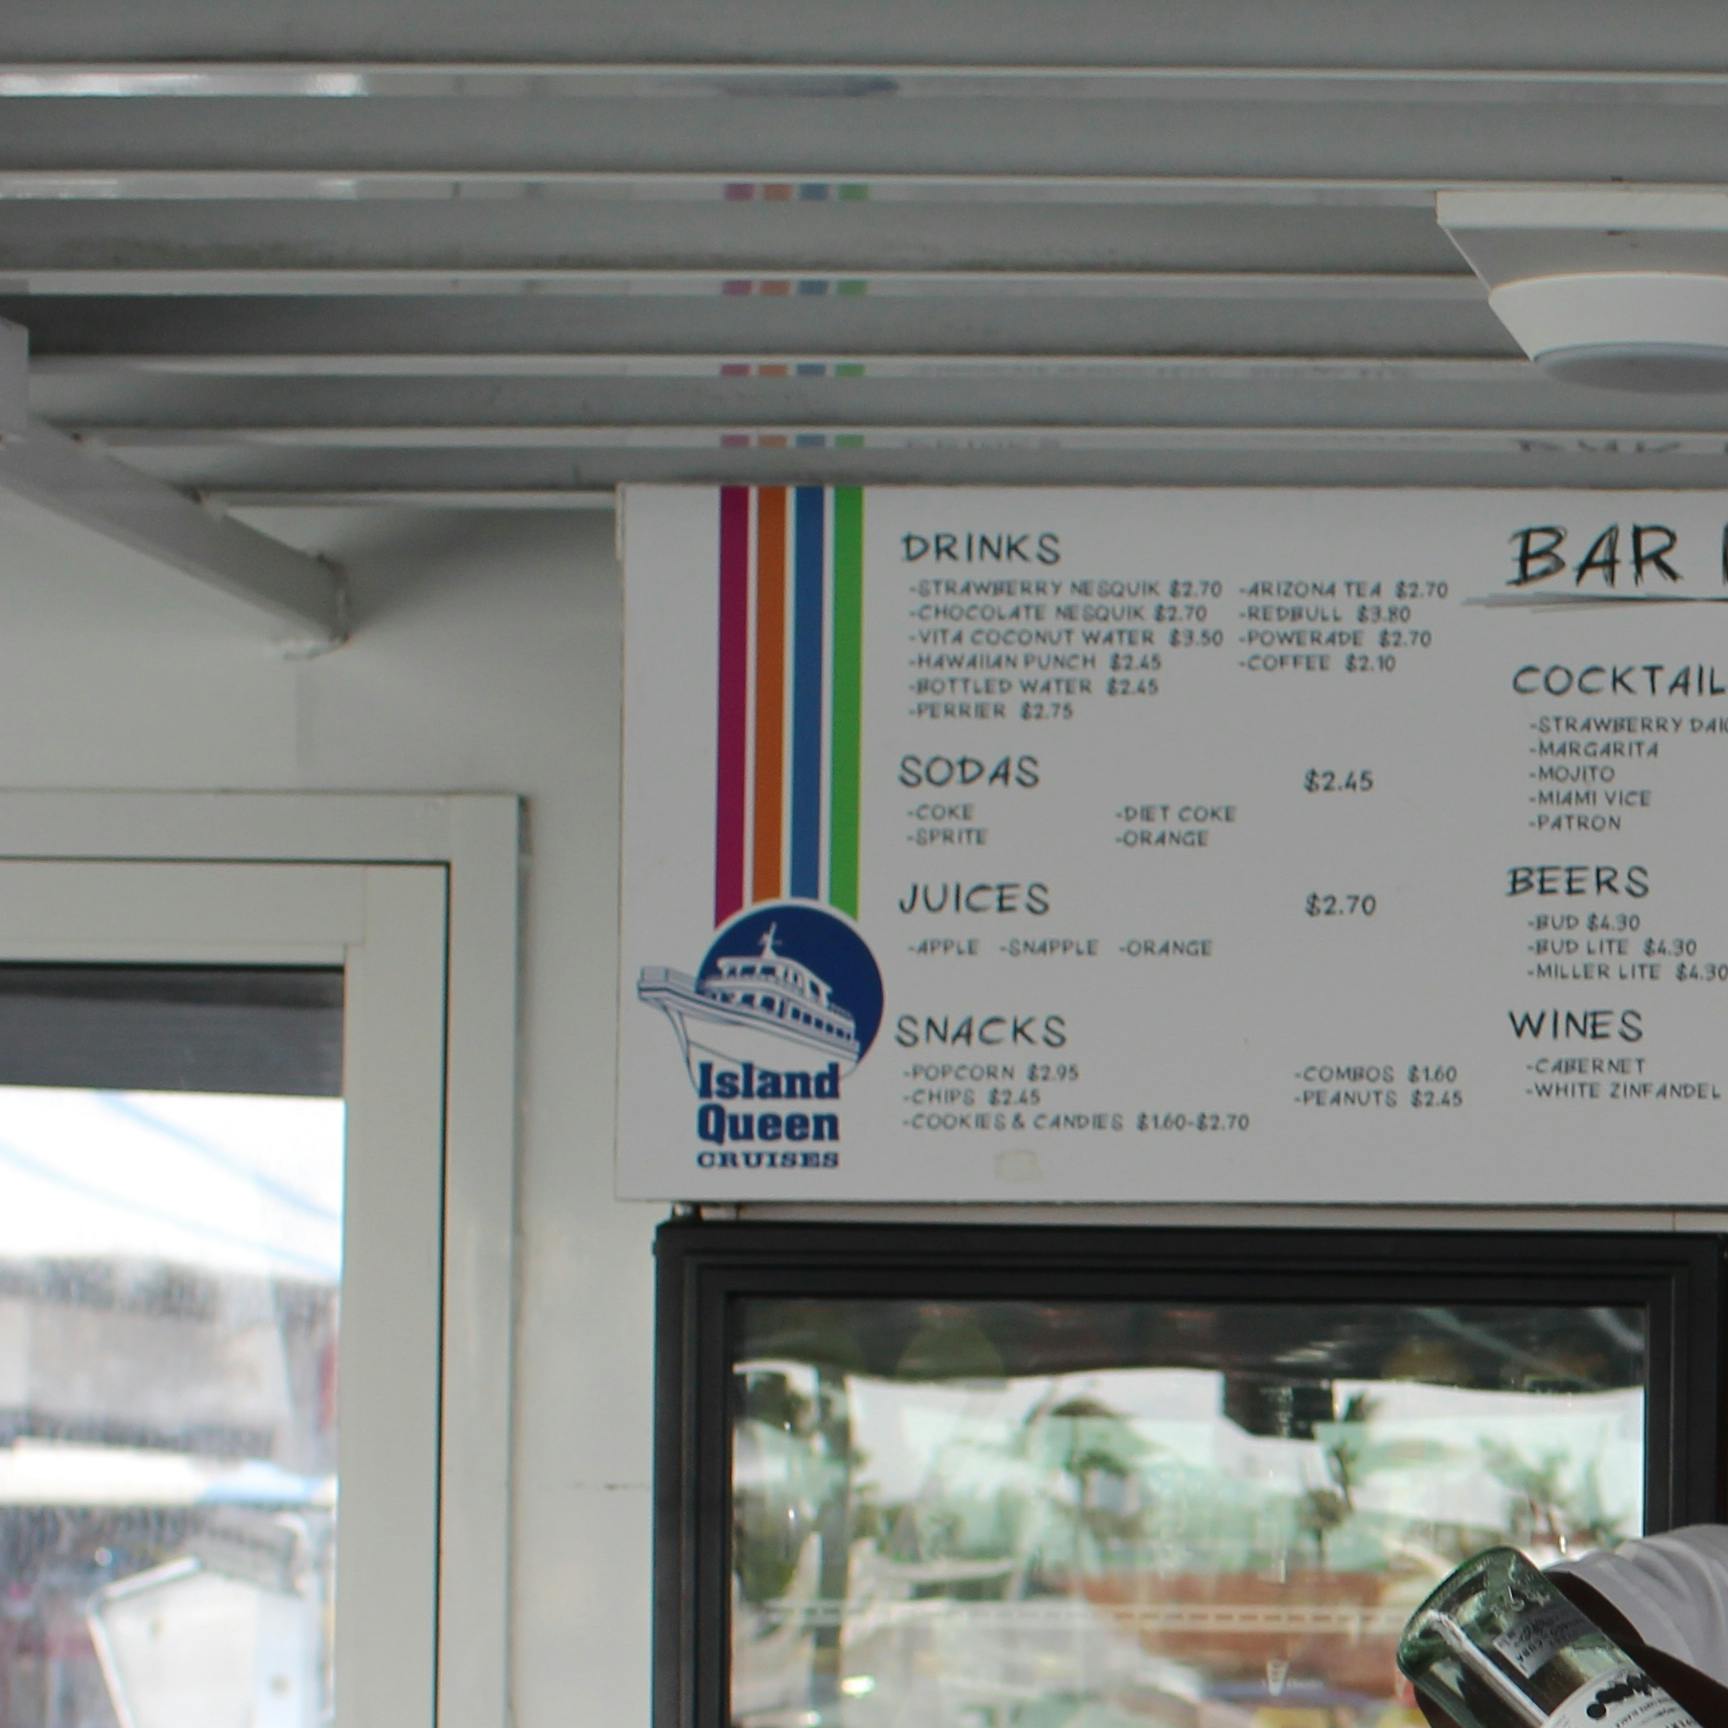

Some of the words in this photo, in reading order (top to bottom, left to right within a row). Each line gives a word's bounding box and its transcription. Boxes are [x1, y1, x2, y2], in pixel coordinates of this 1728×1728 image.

[900, 531, 1062, 567] DRINKS
[1507, 524, 1683, 586] BAR
[1070, 579, 1161, 599] NESQUIK
[1168, 578, 1224, 600] $2.70
[1343, 579, 1382, 599] TEA
[1394, 579, 1449, 601] $2.70
[1055, 604, 1145, 623] NESQUIK
[1153, 603, 1208, 624] $2.70
[1356, 603, 1412, 625] $3.80
[970, 628, 1075, 647] COCONUT
[1081, 628, 1155, 647] WATER
[1168, 627, 1225, 649] $3.50
[1378, 628, 1433, 649] $2.70
[1023, 653, 1096, 671] PUNCH
[1109, 651, 1163, 673] $2.45
[1344, 652, 1397, 674] $2.10
[1019, 677, 1093, 696] WATER
[1105, 675, 1160, 698] $2.45
[1019, 700, 1075, 722] $2.75
[896, 753, 1041, 790] SODAS
[1302, 767, 1375, 795] $2.45
[1604, 789, 1653, 808] VICE
[1177, 804, 1237, 824] COKE
[1504, 864, 1651, 900] BEERS
[897, 880, 1051, 917] JUICES
[1304, 890, 1378, 919] $2.70
[1585, 911, 1641, 934] $4.30
[1586, 937, 1629, 957] LITE
[1642, 936, 1698, 959] $4.30
[1618, 962, 1662, 982] LITE
[893, 1013, 1068, 1050] SNACKS
[1507, 1007, 1644, 1044] WINES
[698, 1061, 840, 1100] Island
[1026, 1062, 1080, 1084] $2.95
[1407, 1063, 1458, 1085] $1.60
[988, 1086, 1041, 1107] $2.45
[1409, 1087, 1464, 1110] $2.45
[1608, 1081, 1722, 1101] ZINFANDEL
[697, 1104, 840, 1143] Queen
[1032, 1112, 1124, 1133] CANDIES
[1135, 1111, 1251, 1133] $1.60-$2.70
[696, 1152, 839, 1168] CRUISES
